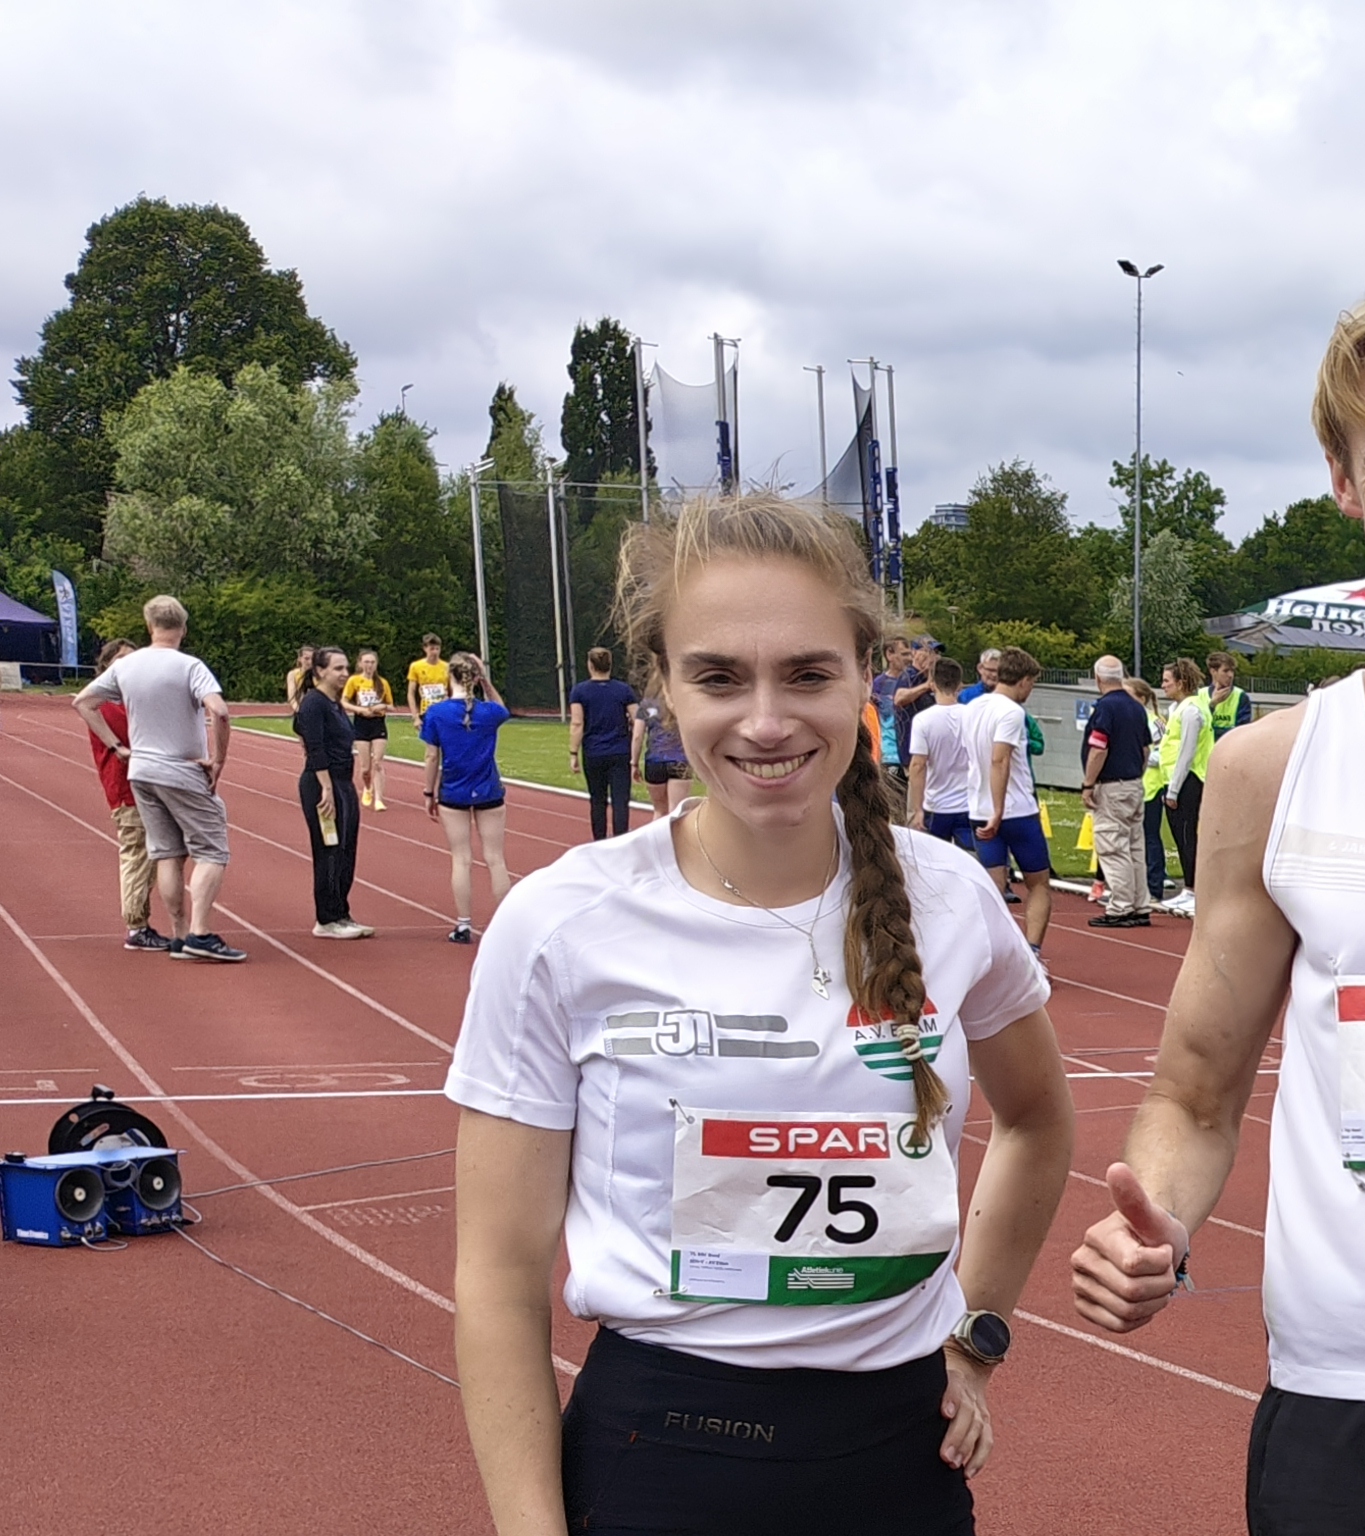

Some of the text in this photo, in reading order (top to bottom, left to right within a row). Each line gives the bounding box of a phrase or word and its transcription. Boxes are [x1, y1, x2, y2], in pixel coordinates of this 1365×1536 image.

[749, 1127, 888, 1153] SPAR
[766, 1174, 879, 1244] 75
[664, 1410, 775, 1443] FUSION
